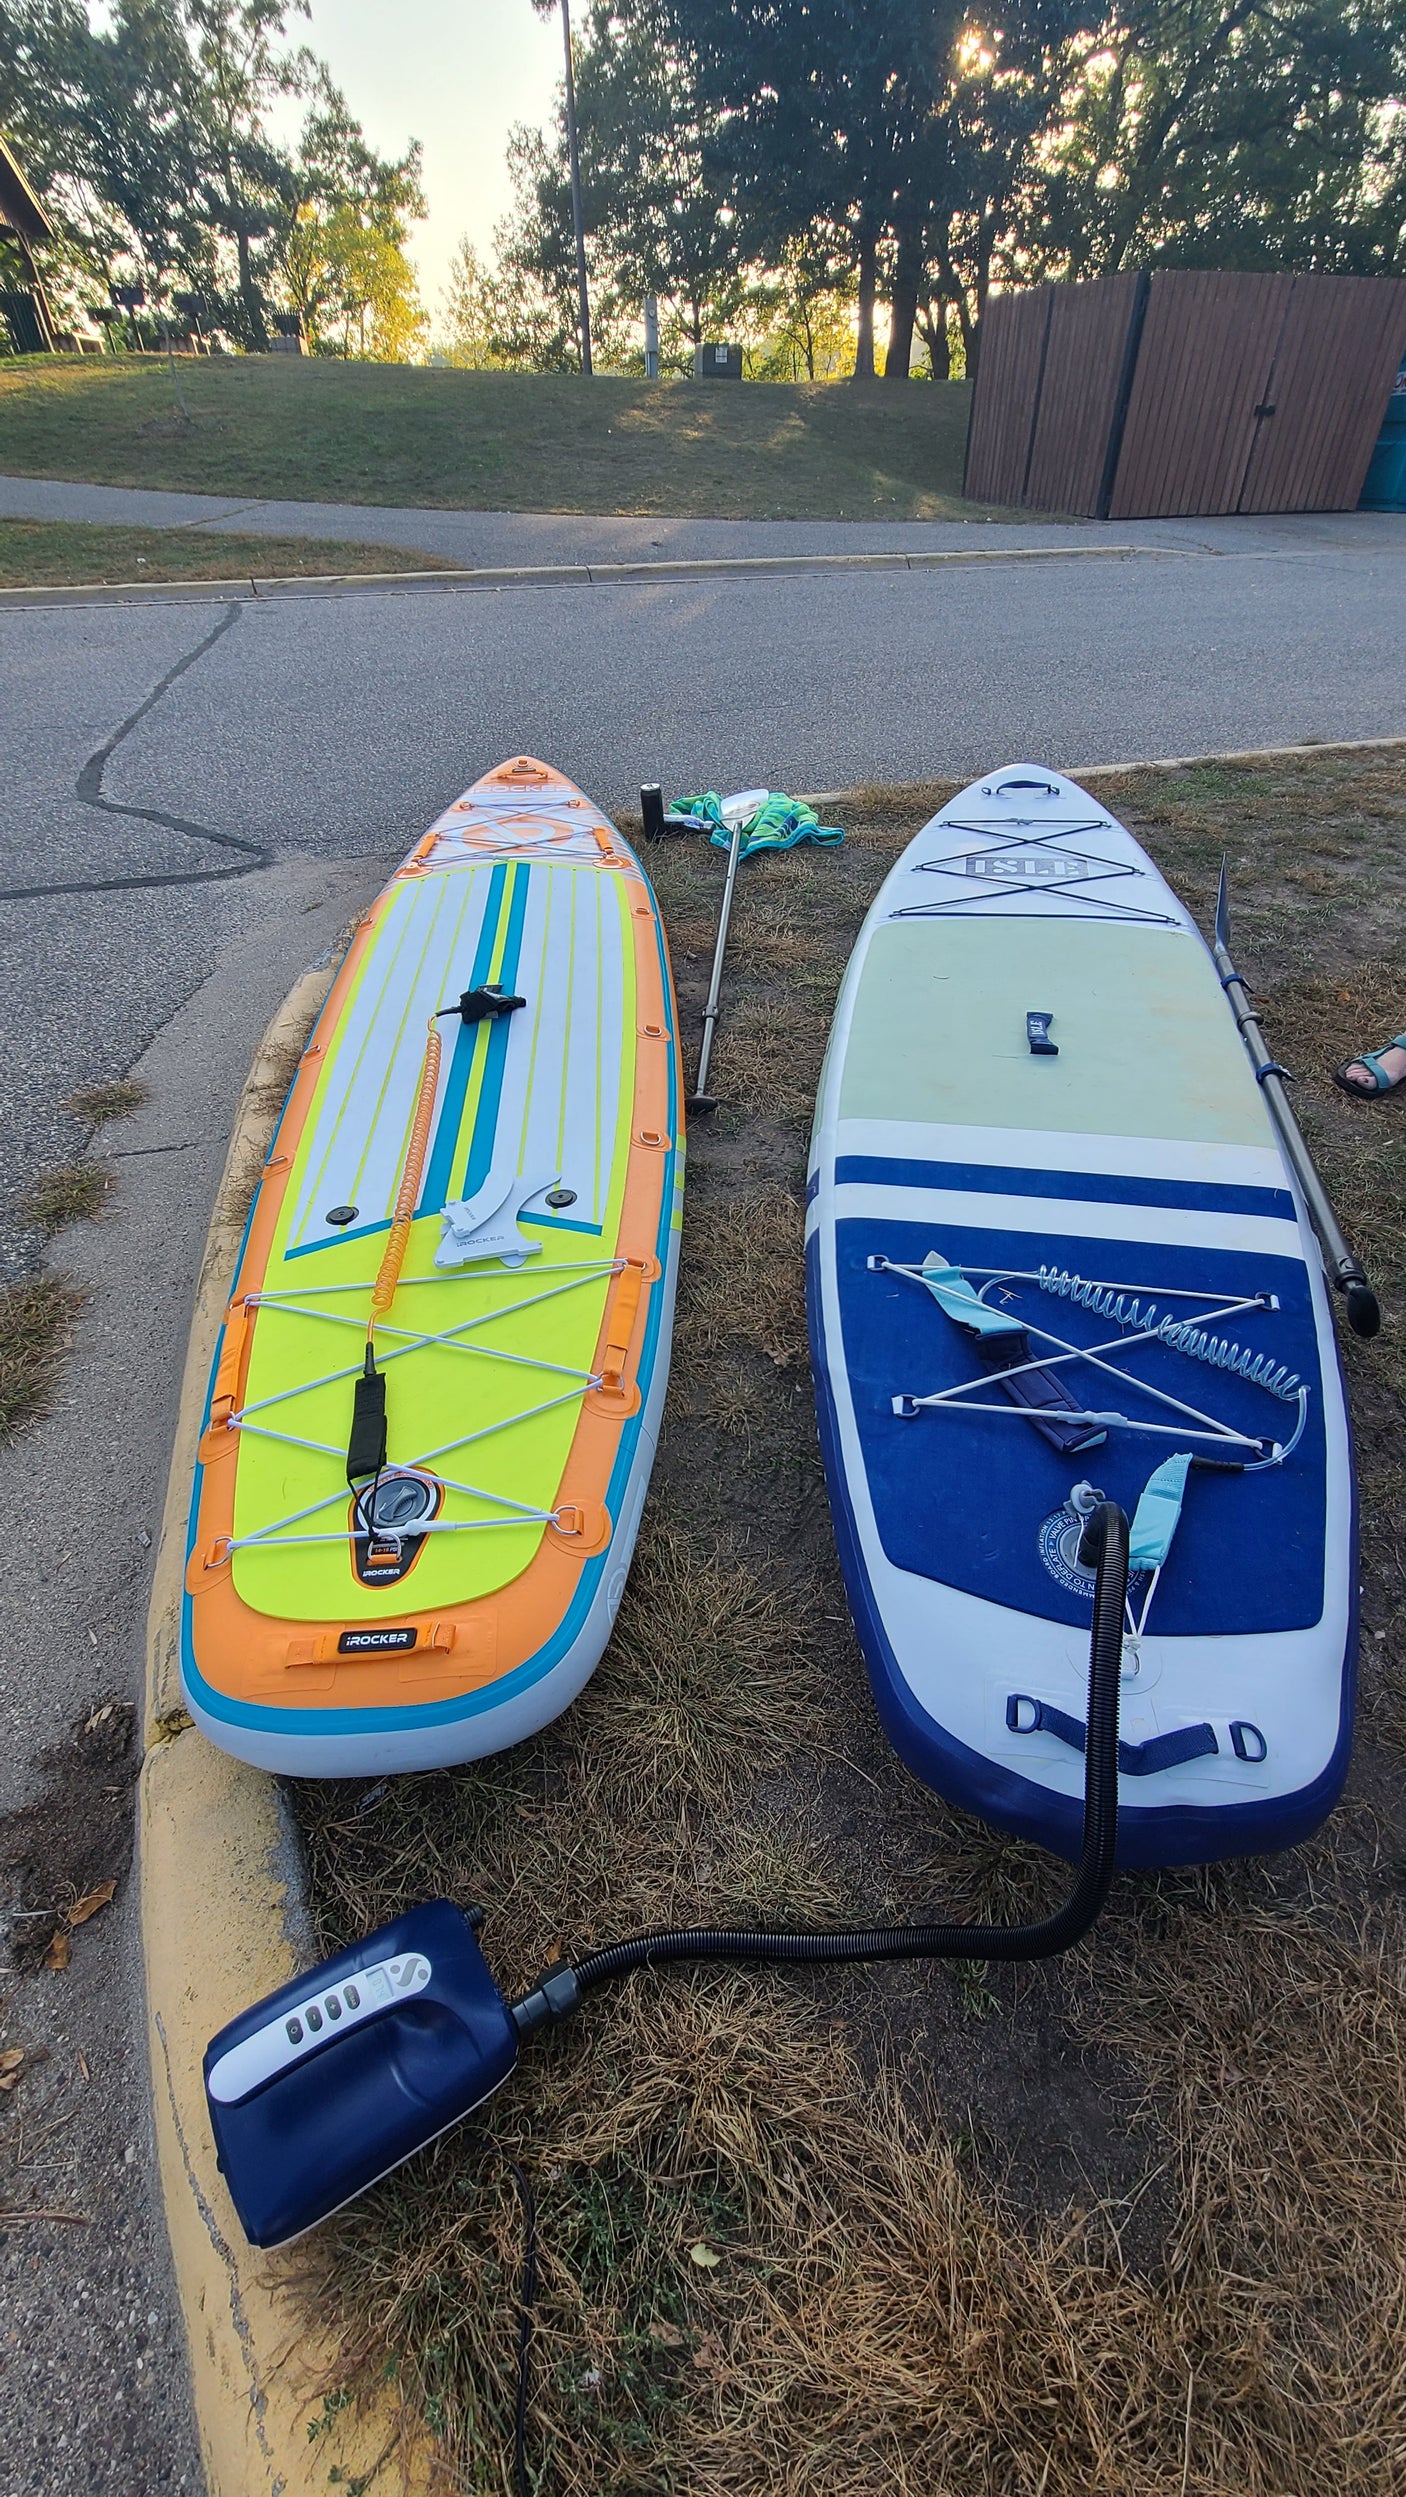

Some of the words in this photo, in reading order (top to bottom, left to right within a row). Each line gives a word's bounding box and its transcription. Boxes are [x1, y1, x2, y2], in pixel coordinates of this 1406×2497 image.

[975, 860, 1081, 875] ISLE
[456, 1235, 504, 1247] iROCKER
[1048, 1521, 1065, 1540] VALVE
[1038, 1527, 1048, 1556] INFLATION
[1049, 1548, 1072, 1580] DEFLATE
[362, 1568, 401, 1577] iROCKER
[1073, 1578, 1087, 1589] TO
[346, 1632, 408, 1647] iROCKER
